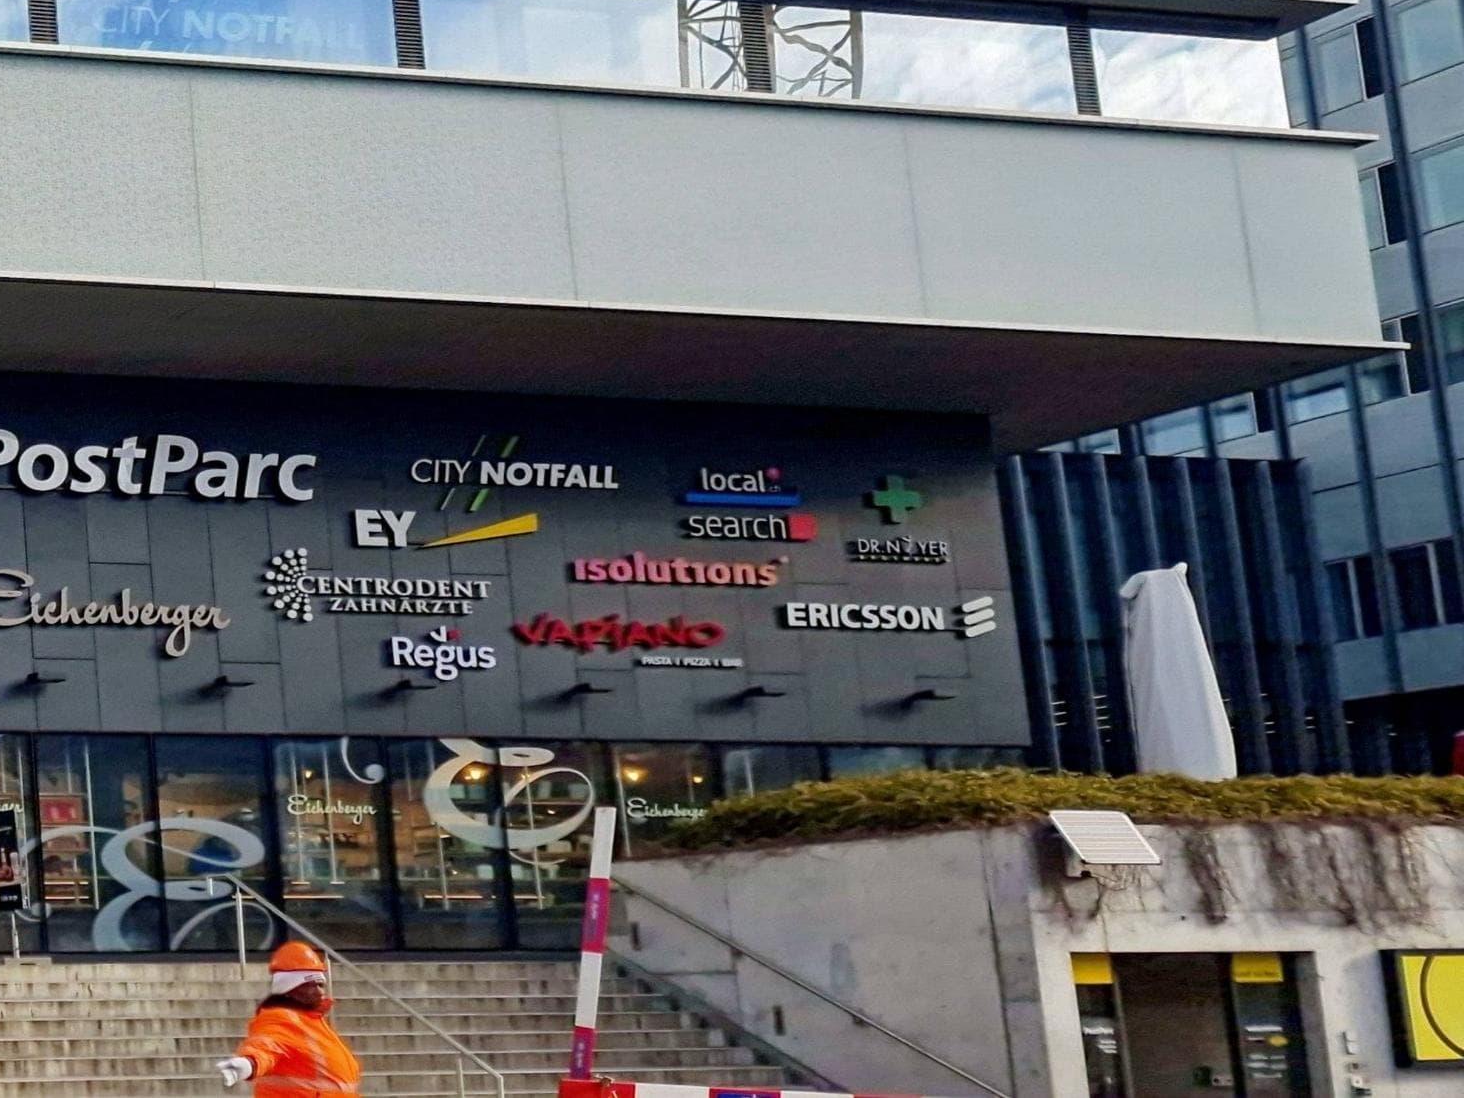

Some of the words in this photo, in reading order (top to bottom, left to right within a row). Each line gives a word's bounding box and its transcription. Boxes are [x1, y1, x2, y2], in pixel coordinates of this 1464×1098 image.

[411, 458, 472, 484] CITY
[479, 460, 619, 489] NOTFALL
[354, 509, 416, 547] EY
[689, 514, 787, 539] search
[296, 576, 492, 599] CENTRODENT
[786, 602, 946, 631] ERICSSON
[391, 636, 497, 681] Regus
[287, 794, 377, 825] Eichenberger
